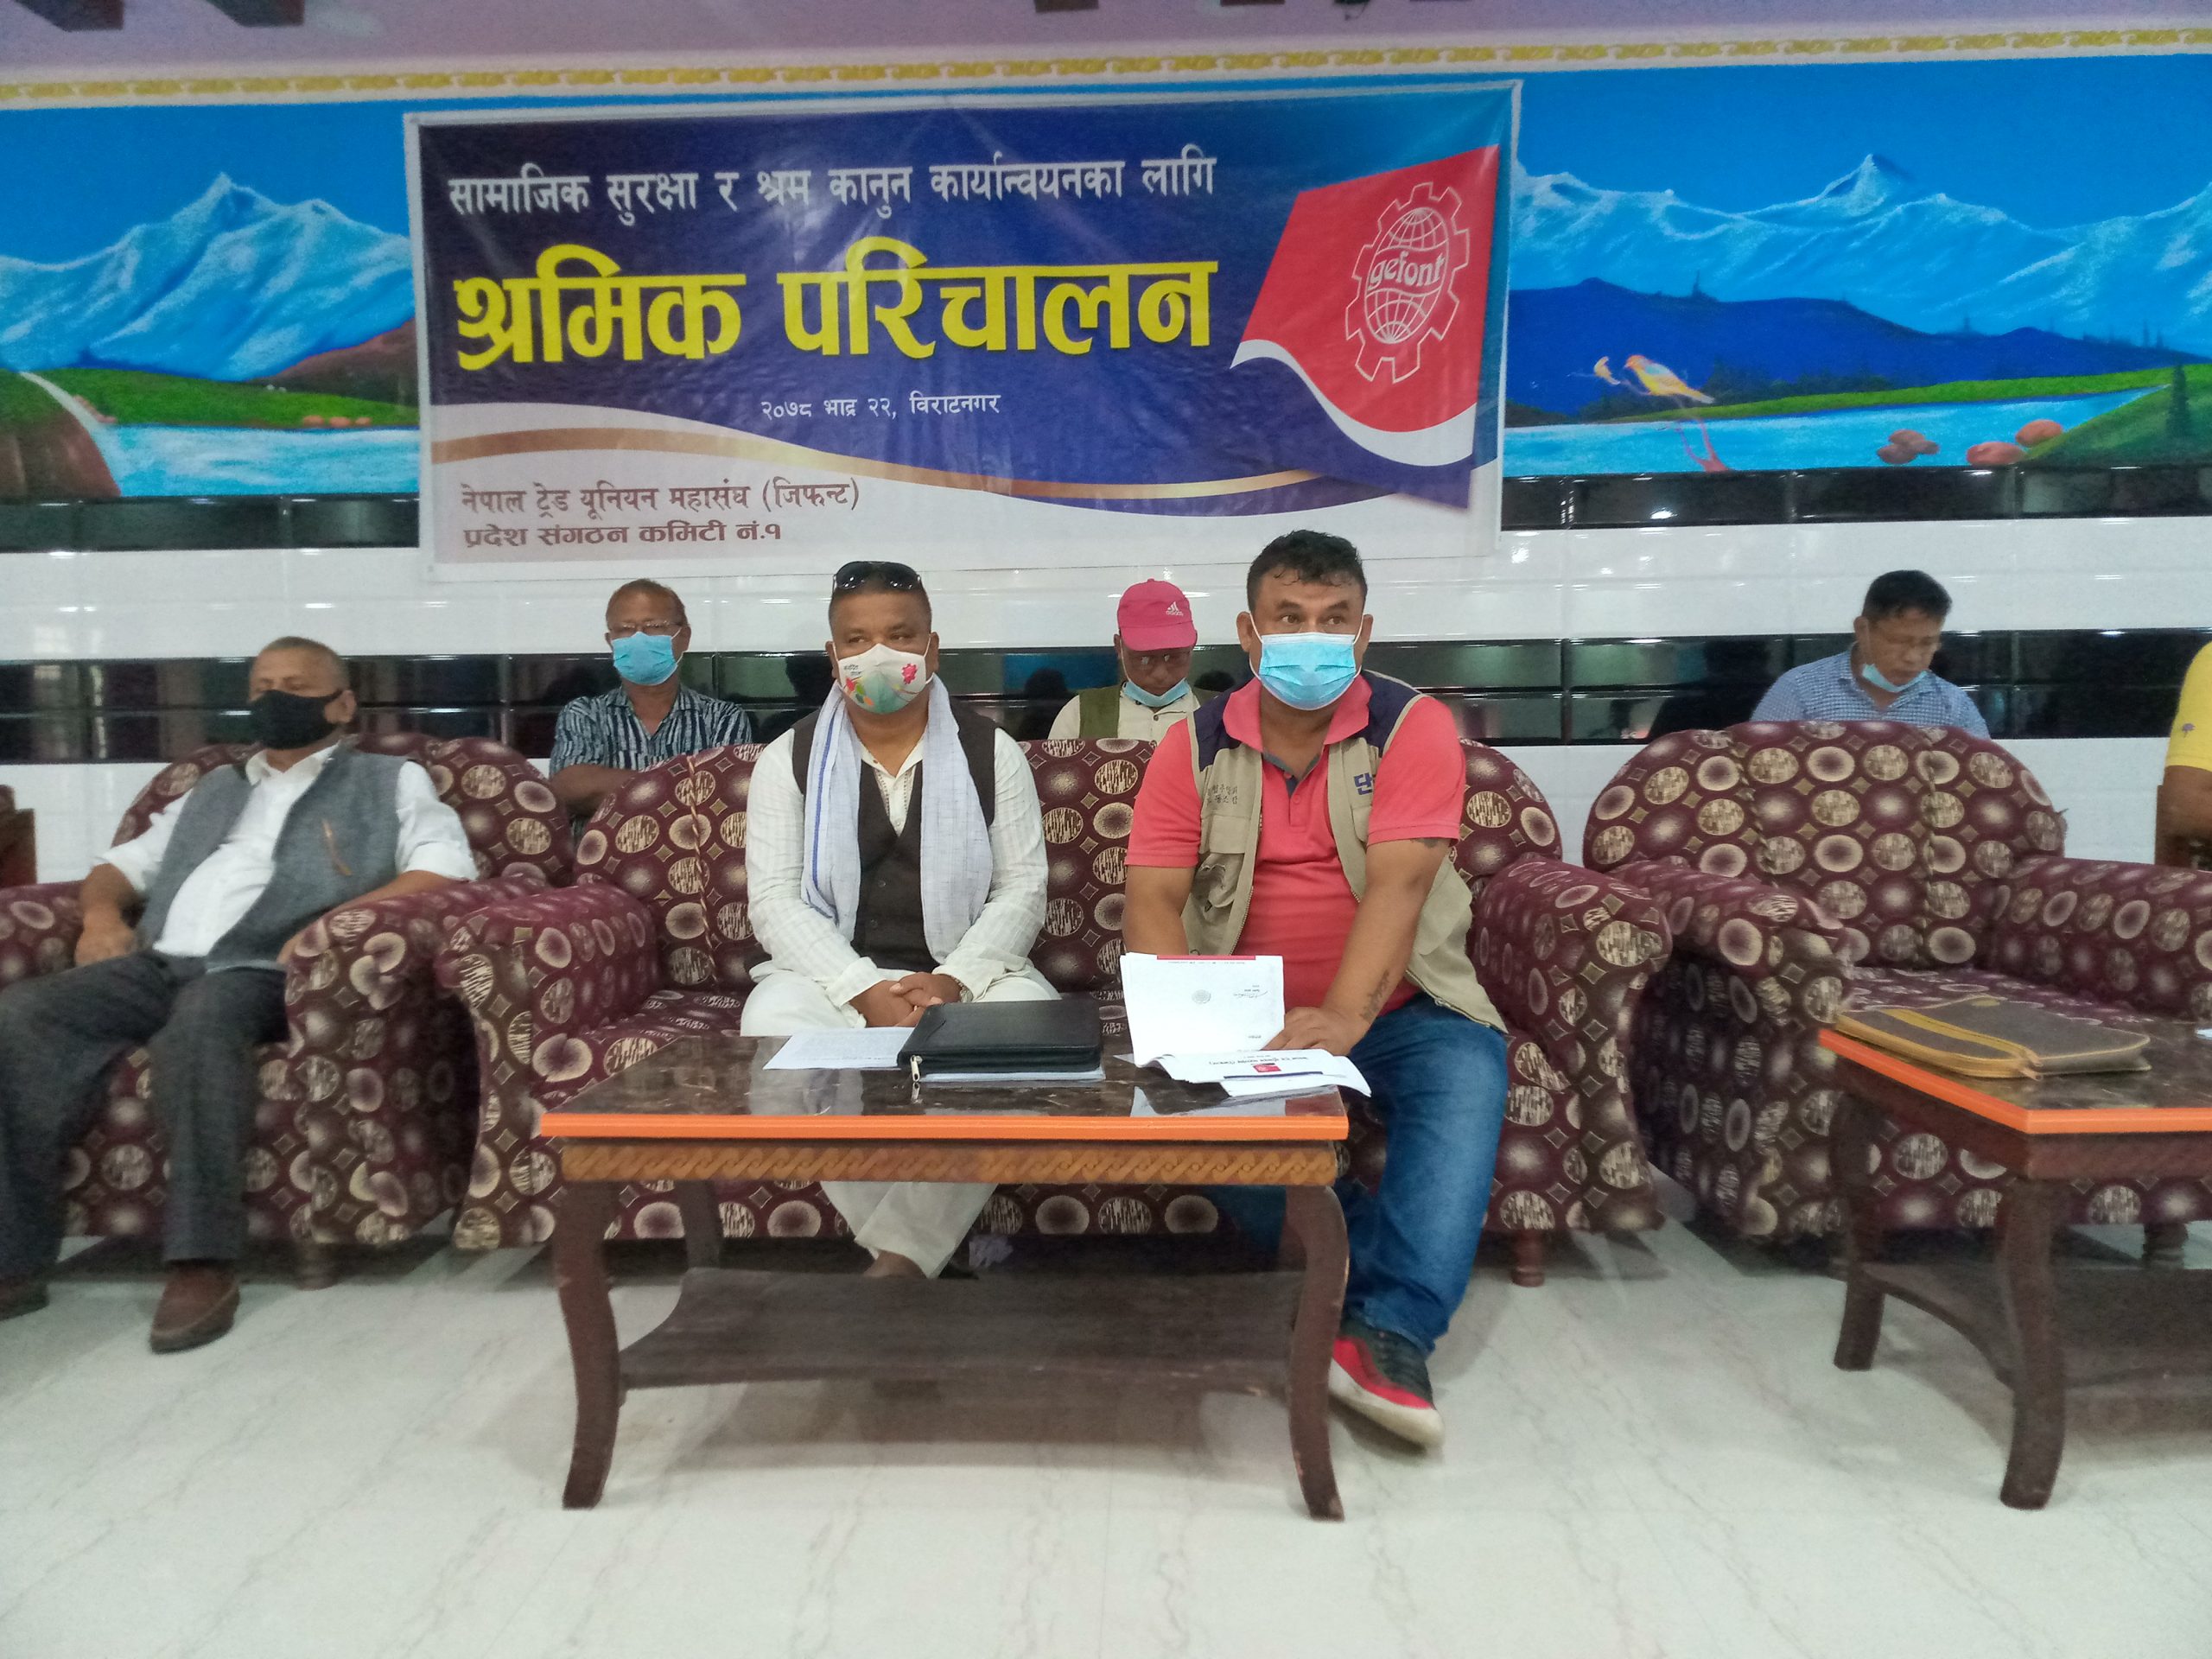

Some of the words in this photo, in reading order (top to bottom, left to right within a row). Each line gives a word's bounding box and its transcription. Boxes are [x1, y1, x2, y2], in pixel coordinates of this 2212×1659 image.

[448, 162, 590, 215] सामाजिक
[607, 172, 699, 226] सुरक्षा
[714, 172, 740, 213] र
[757, 170, 811, 207] श्रम
[828, 166, 913, 219] कानुन
[929, 150, 1126, 202] कार्यान्वयनका
[1141, 143, 1217, 195] लागि
[1368, 251, 1446, 290] gefont
[454, 244, 747, 371] श्रमिक
[777, 236, 1219, 359] परिचालन
[761, 400, 812, 420] २०७८
[823, 397, 858, 417] भाद्र
[868, 397, 897, 419] २२,
[909, 390, 1001, 416] विराटनगर
[461, 482, 527, 513] नेपाल
[532, 481, 571, 518] ट्रेड
[580, 480, 659, 520] यूनियन
[669, 478, 751, 512] महासंघ
[463, 523, 529, 548] प्रदेश
[537, 524, 630, 546] संगठन
[638, 518, 727, 544] कमिटी
